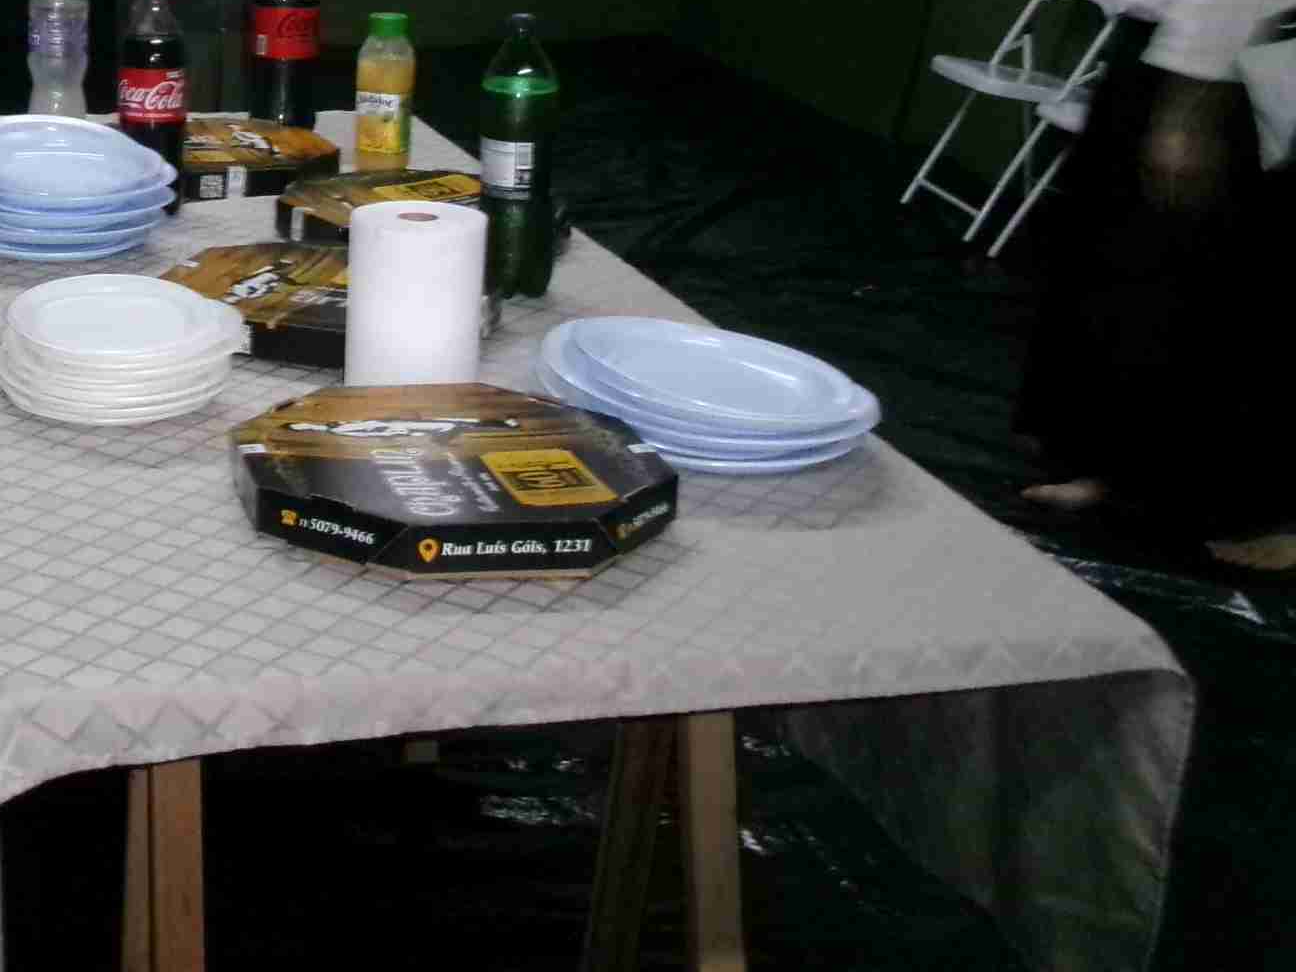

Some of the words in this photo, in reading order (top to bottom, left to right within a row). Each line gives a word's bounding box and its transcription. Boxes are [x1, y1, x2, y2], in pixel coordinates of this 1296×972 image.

[309, 518, 376, 546] 5079-9466
[442, 542, 471, 557] Rua
[554, 538, 593, 553] 1231
